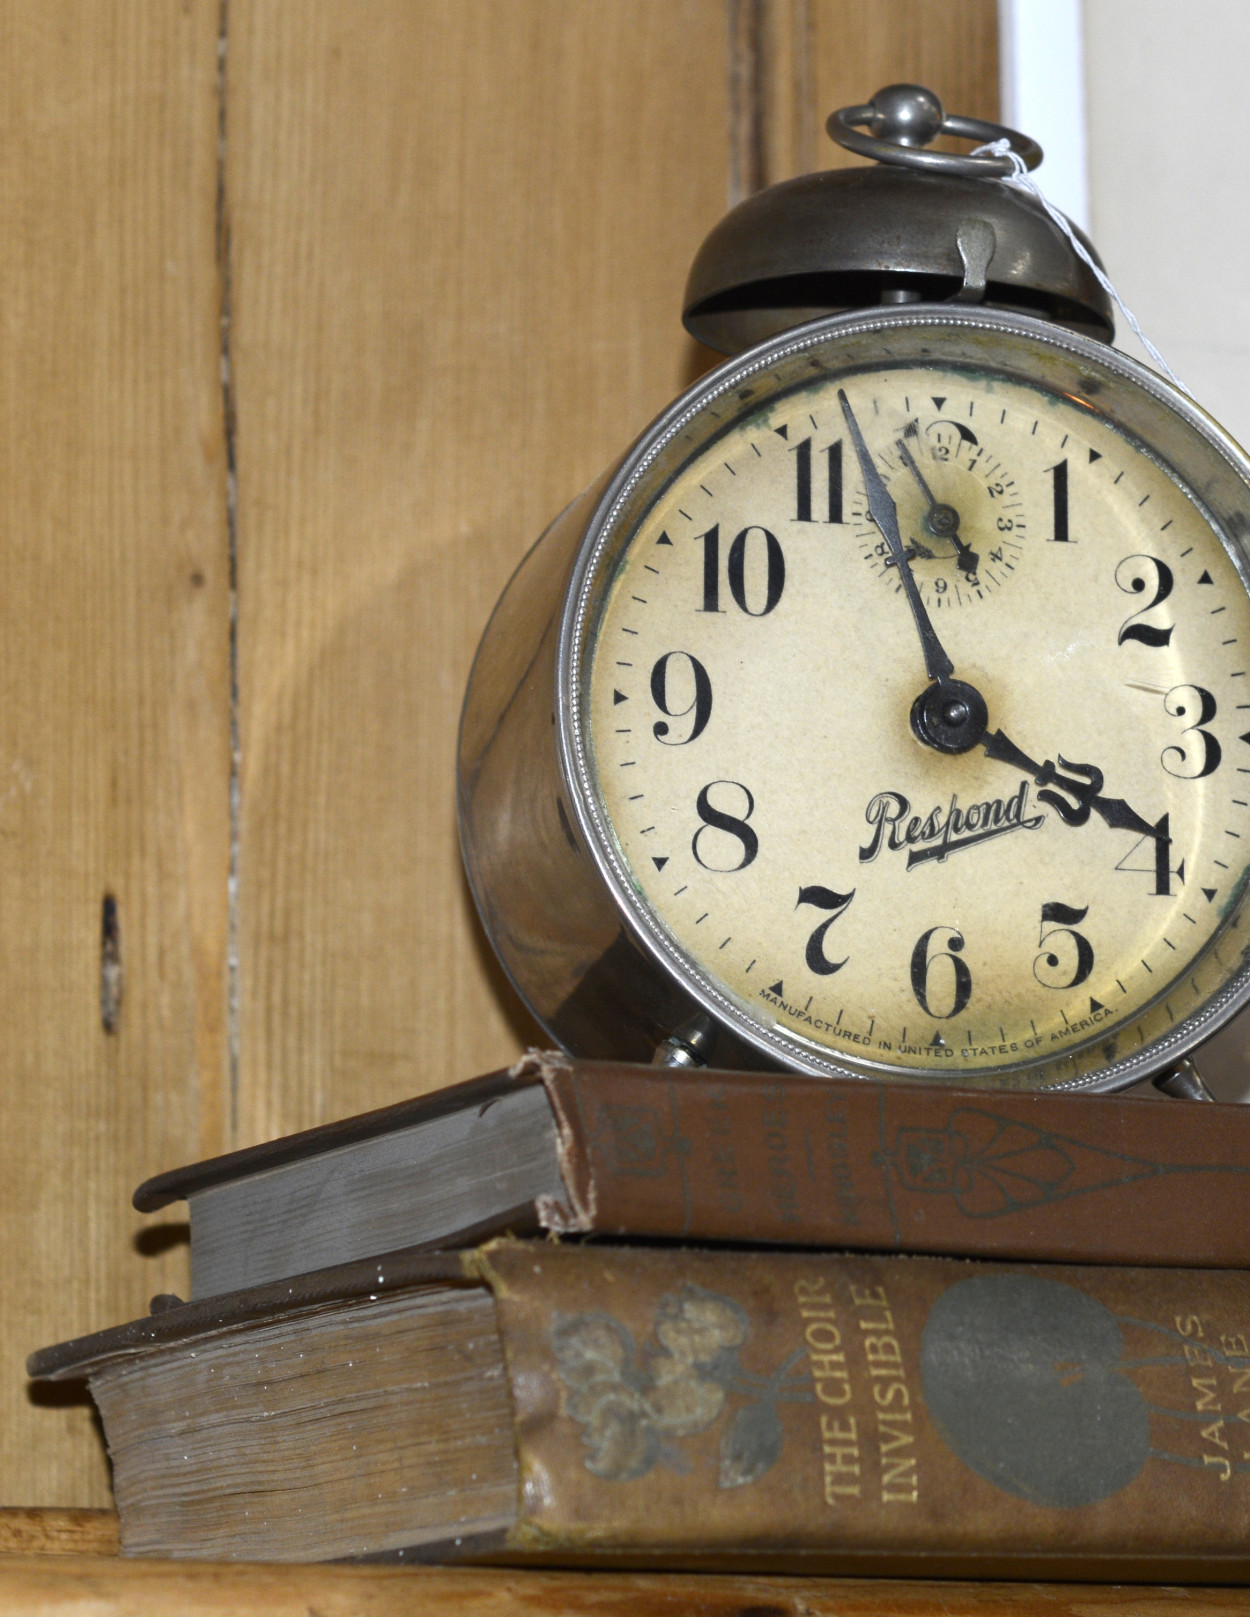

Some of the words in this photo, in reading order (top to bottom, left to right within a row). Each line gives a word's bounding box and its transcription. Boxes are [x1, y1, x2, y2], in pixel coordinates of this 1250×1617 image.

[787, 437, 851, 525] 11
[1043, 457, 1079, 544] 1
[693, 522, 786, 617] 10
[1114, 553, 1177, 648] 2
[649, 650, 713, 746] 9
[1160, 684, 1222, 780] 3
[691, 780, 759, 873] 8
[858, 779, 1046, 873] Respond
[1114, 811, 1186, 896] 4
[794, 885, 857, 976] 7
[910, 926, 973, 1020] 6
[1033, 901, 1095, 989] 5
[758, 988, 872, 1047] MANUFACTURED
[878, 1040, 893, 1051] IN
[898, 1045, 955, 1058] UNITED
[960, 1041, 1020, 1058] STATES
[1023, 1035, 1044, 1049] OF
[794, 1276, 852, 1406] CHOIR
[850, 1284, 919, 1504] INVISIBLE
[1174, 1314, 1232, 1482] JAMES
[820, 1413, 861, 1506] THE
